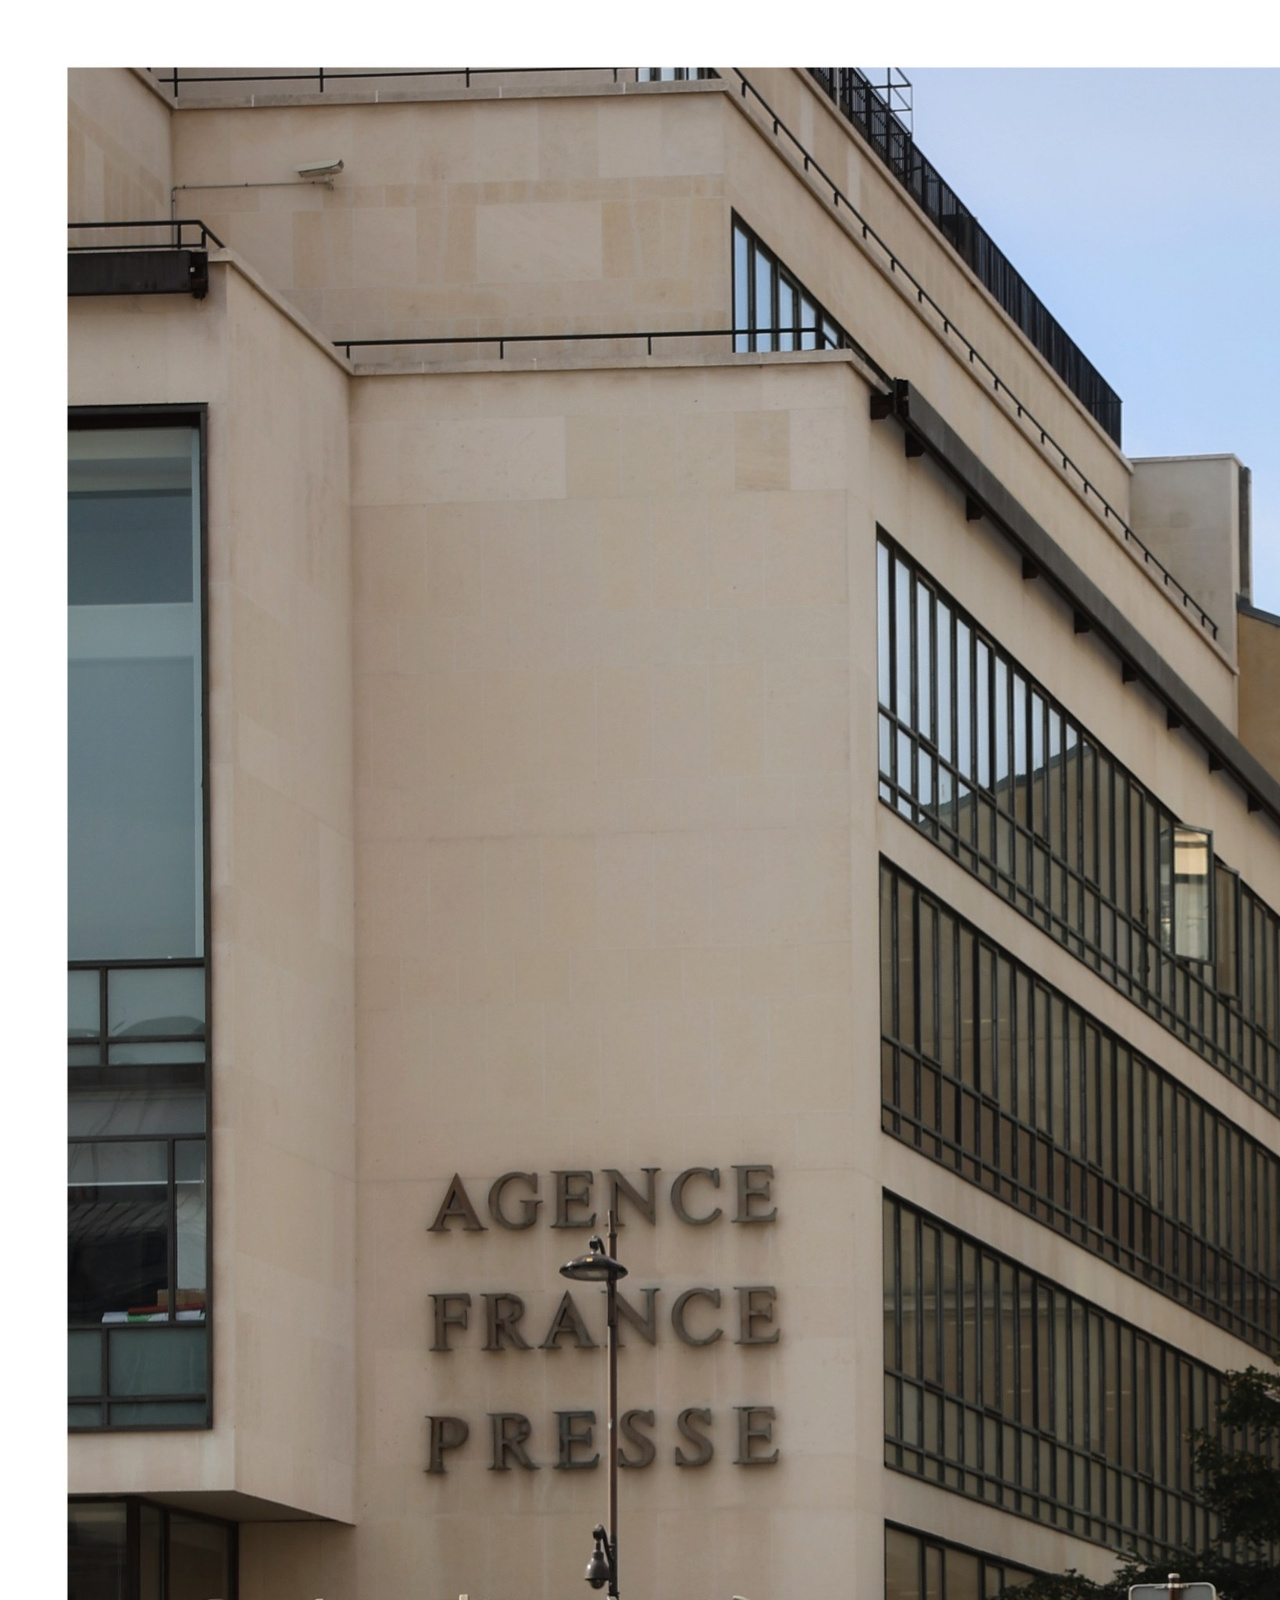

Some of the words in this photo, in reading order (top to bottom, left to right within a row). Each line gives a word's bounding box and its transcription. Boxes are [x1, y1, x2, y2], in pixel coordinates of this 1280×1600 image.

[426, 1164, 779, 1233] AGENCE
[427, 1286, 781, 1352] FRANCE
[423, 1406, 780, 1474] PRESSE
